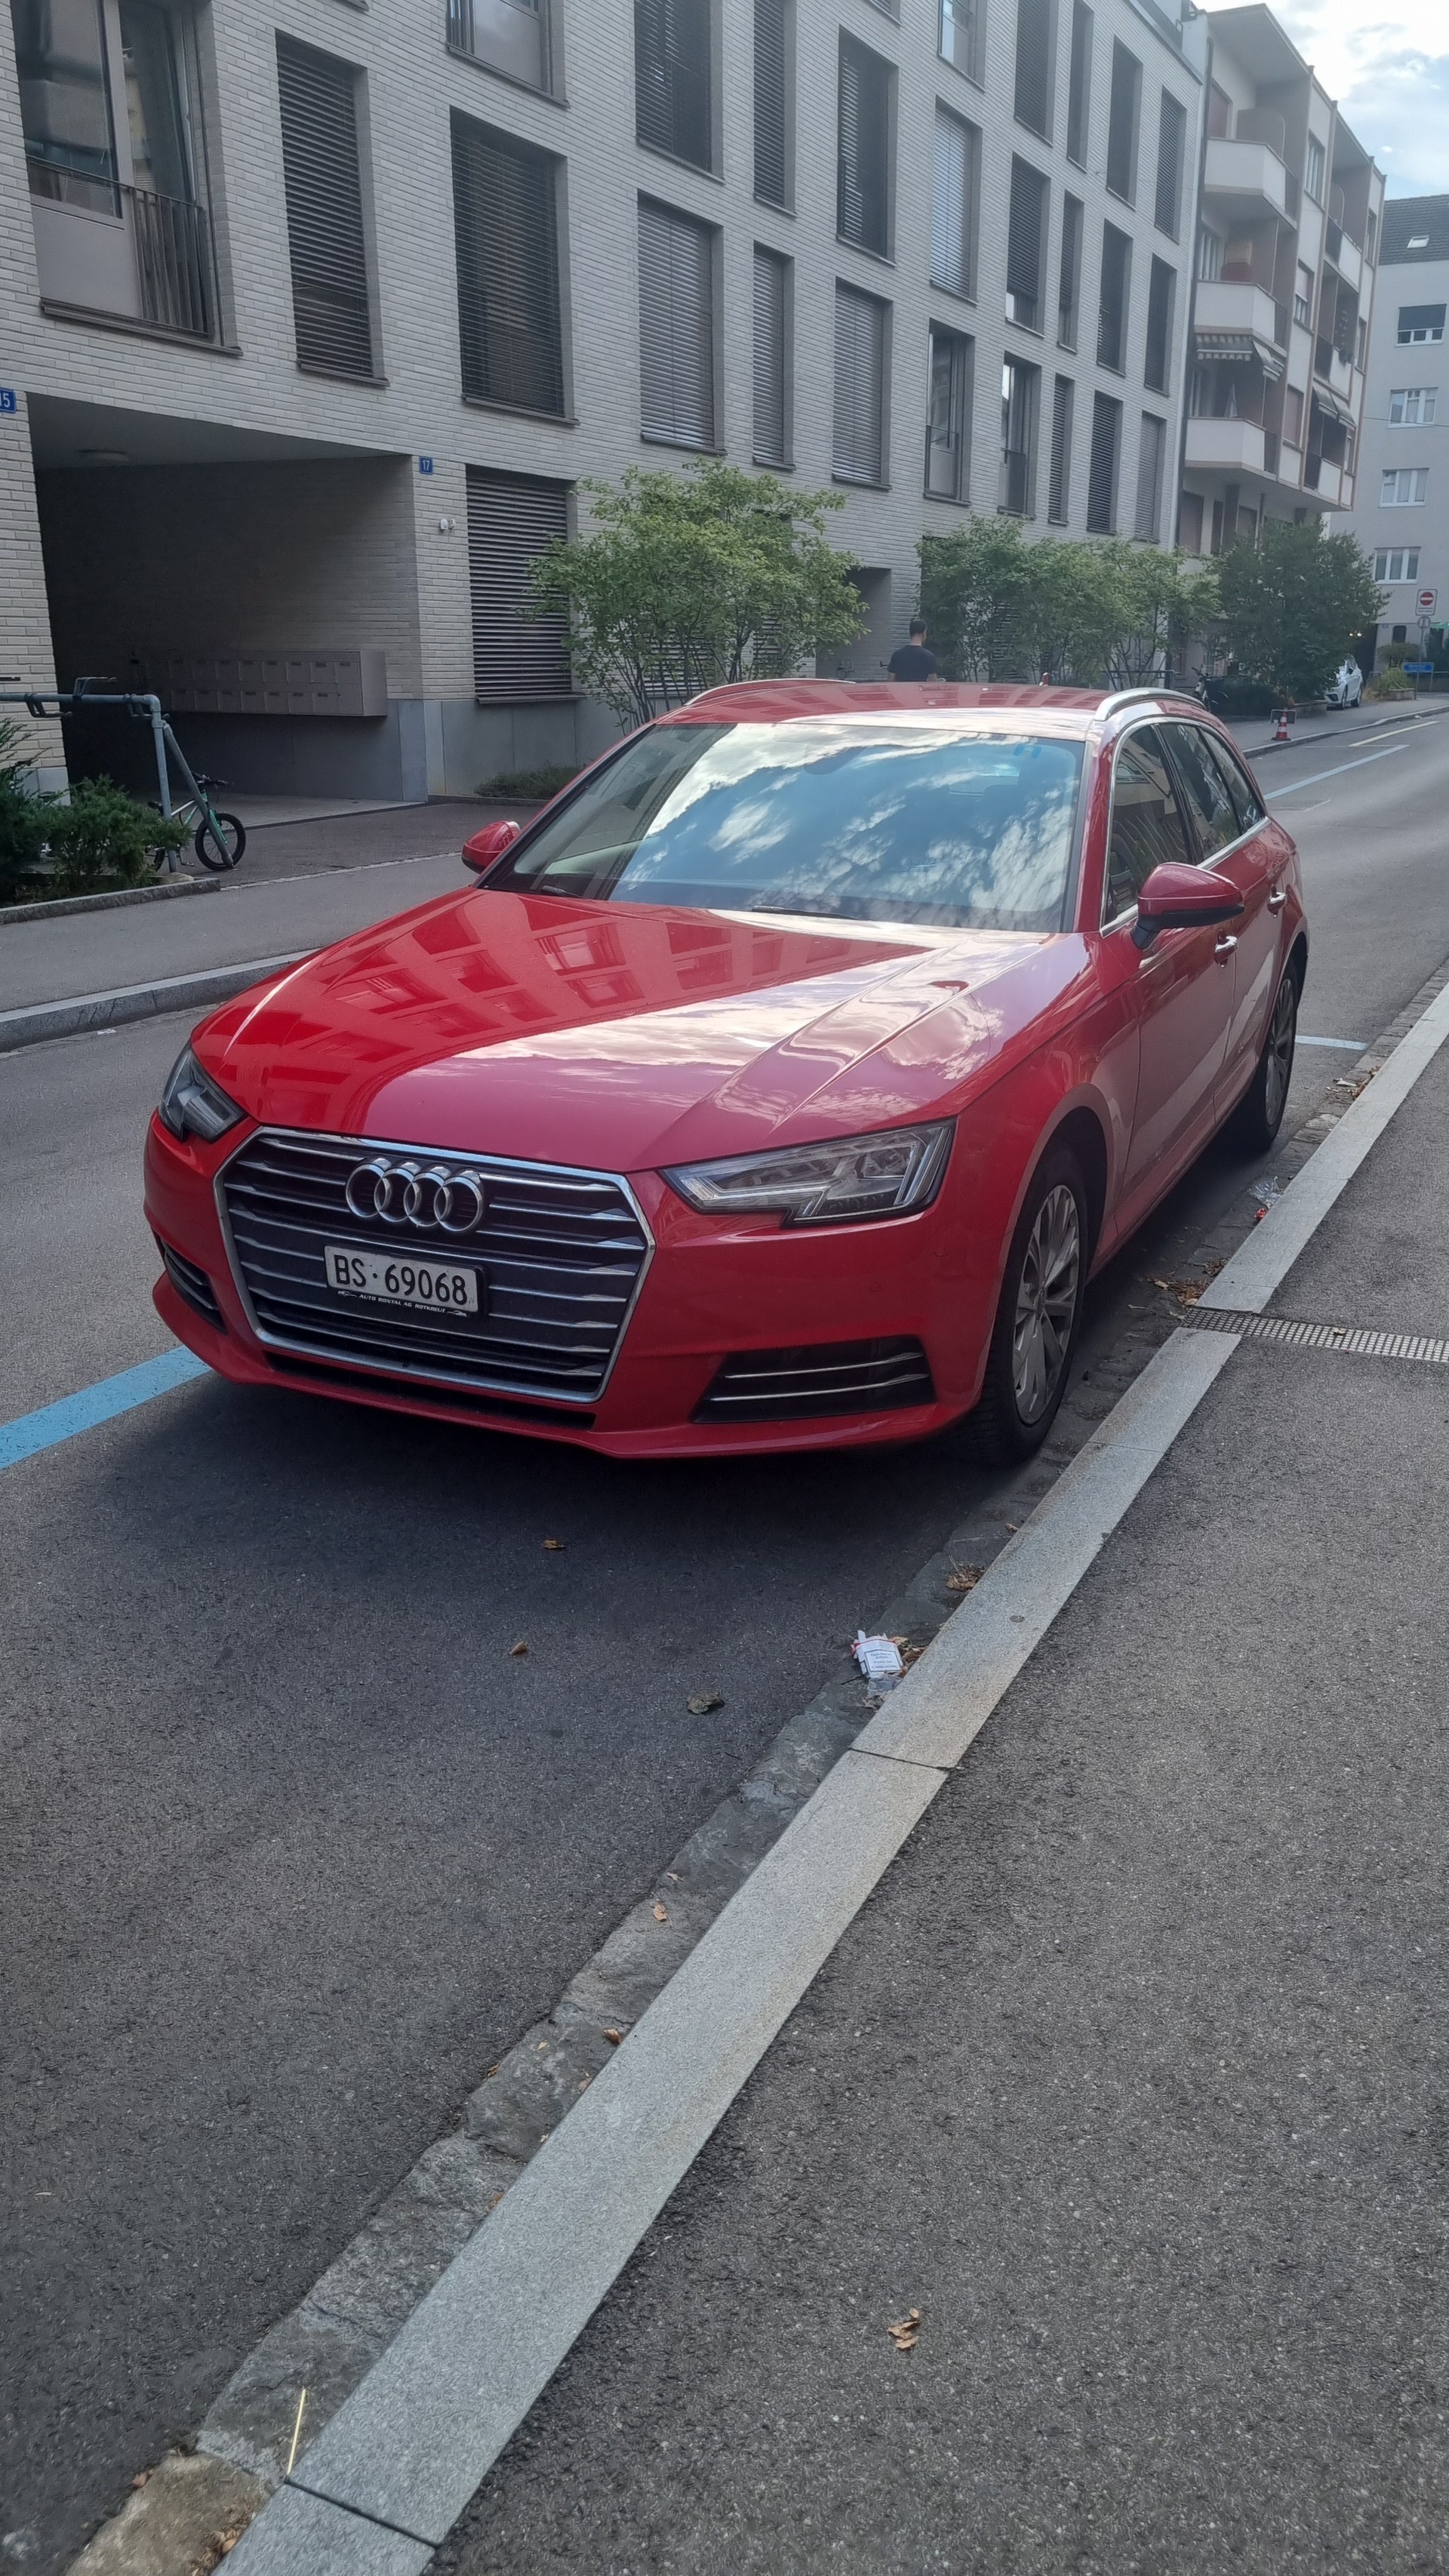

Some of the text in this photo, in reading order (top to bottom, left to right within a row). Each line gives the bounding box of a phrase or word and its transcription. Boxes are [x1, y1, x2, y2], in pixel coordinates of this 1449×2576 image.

[423, 459, 430, 471] 17
[378, 1297, 401, 1306] RONTAL
[414, 1303, 446, 1313] ROTKREUZ
